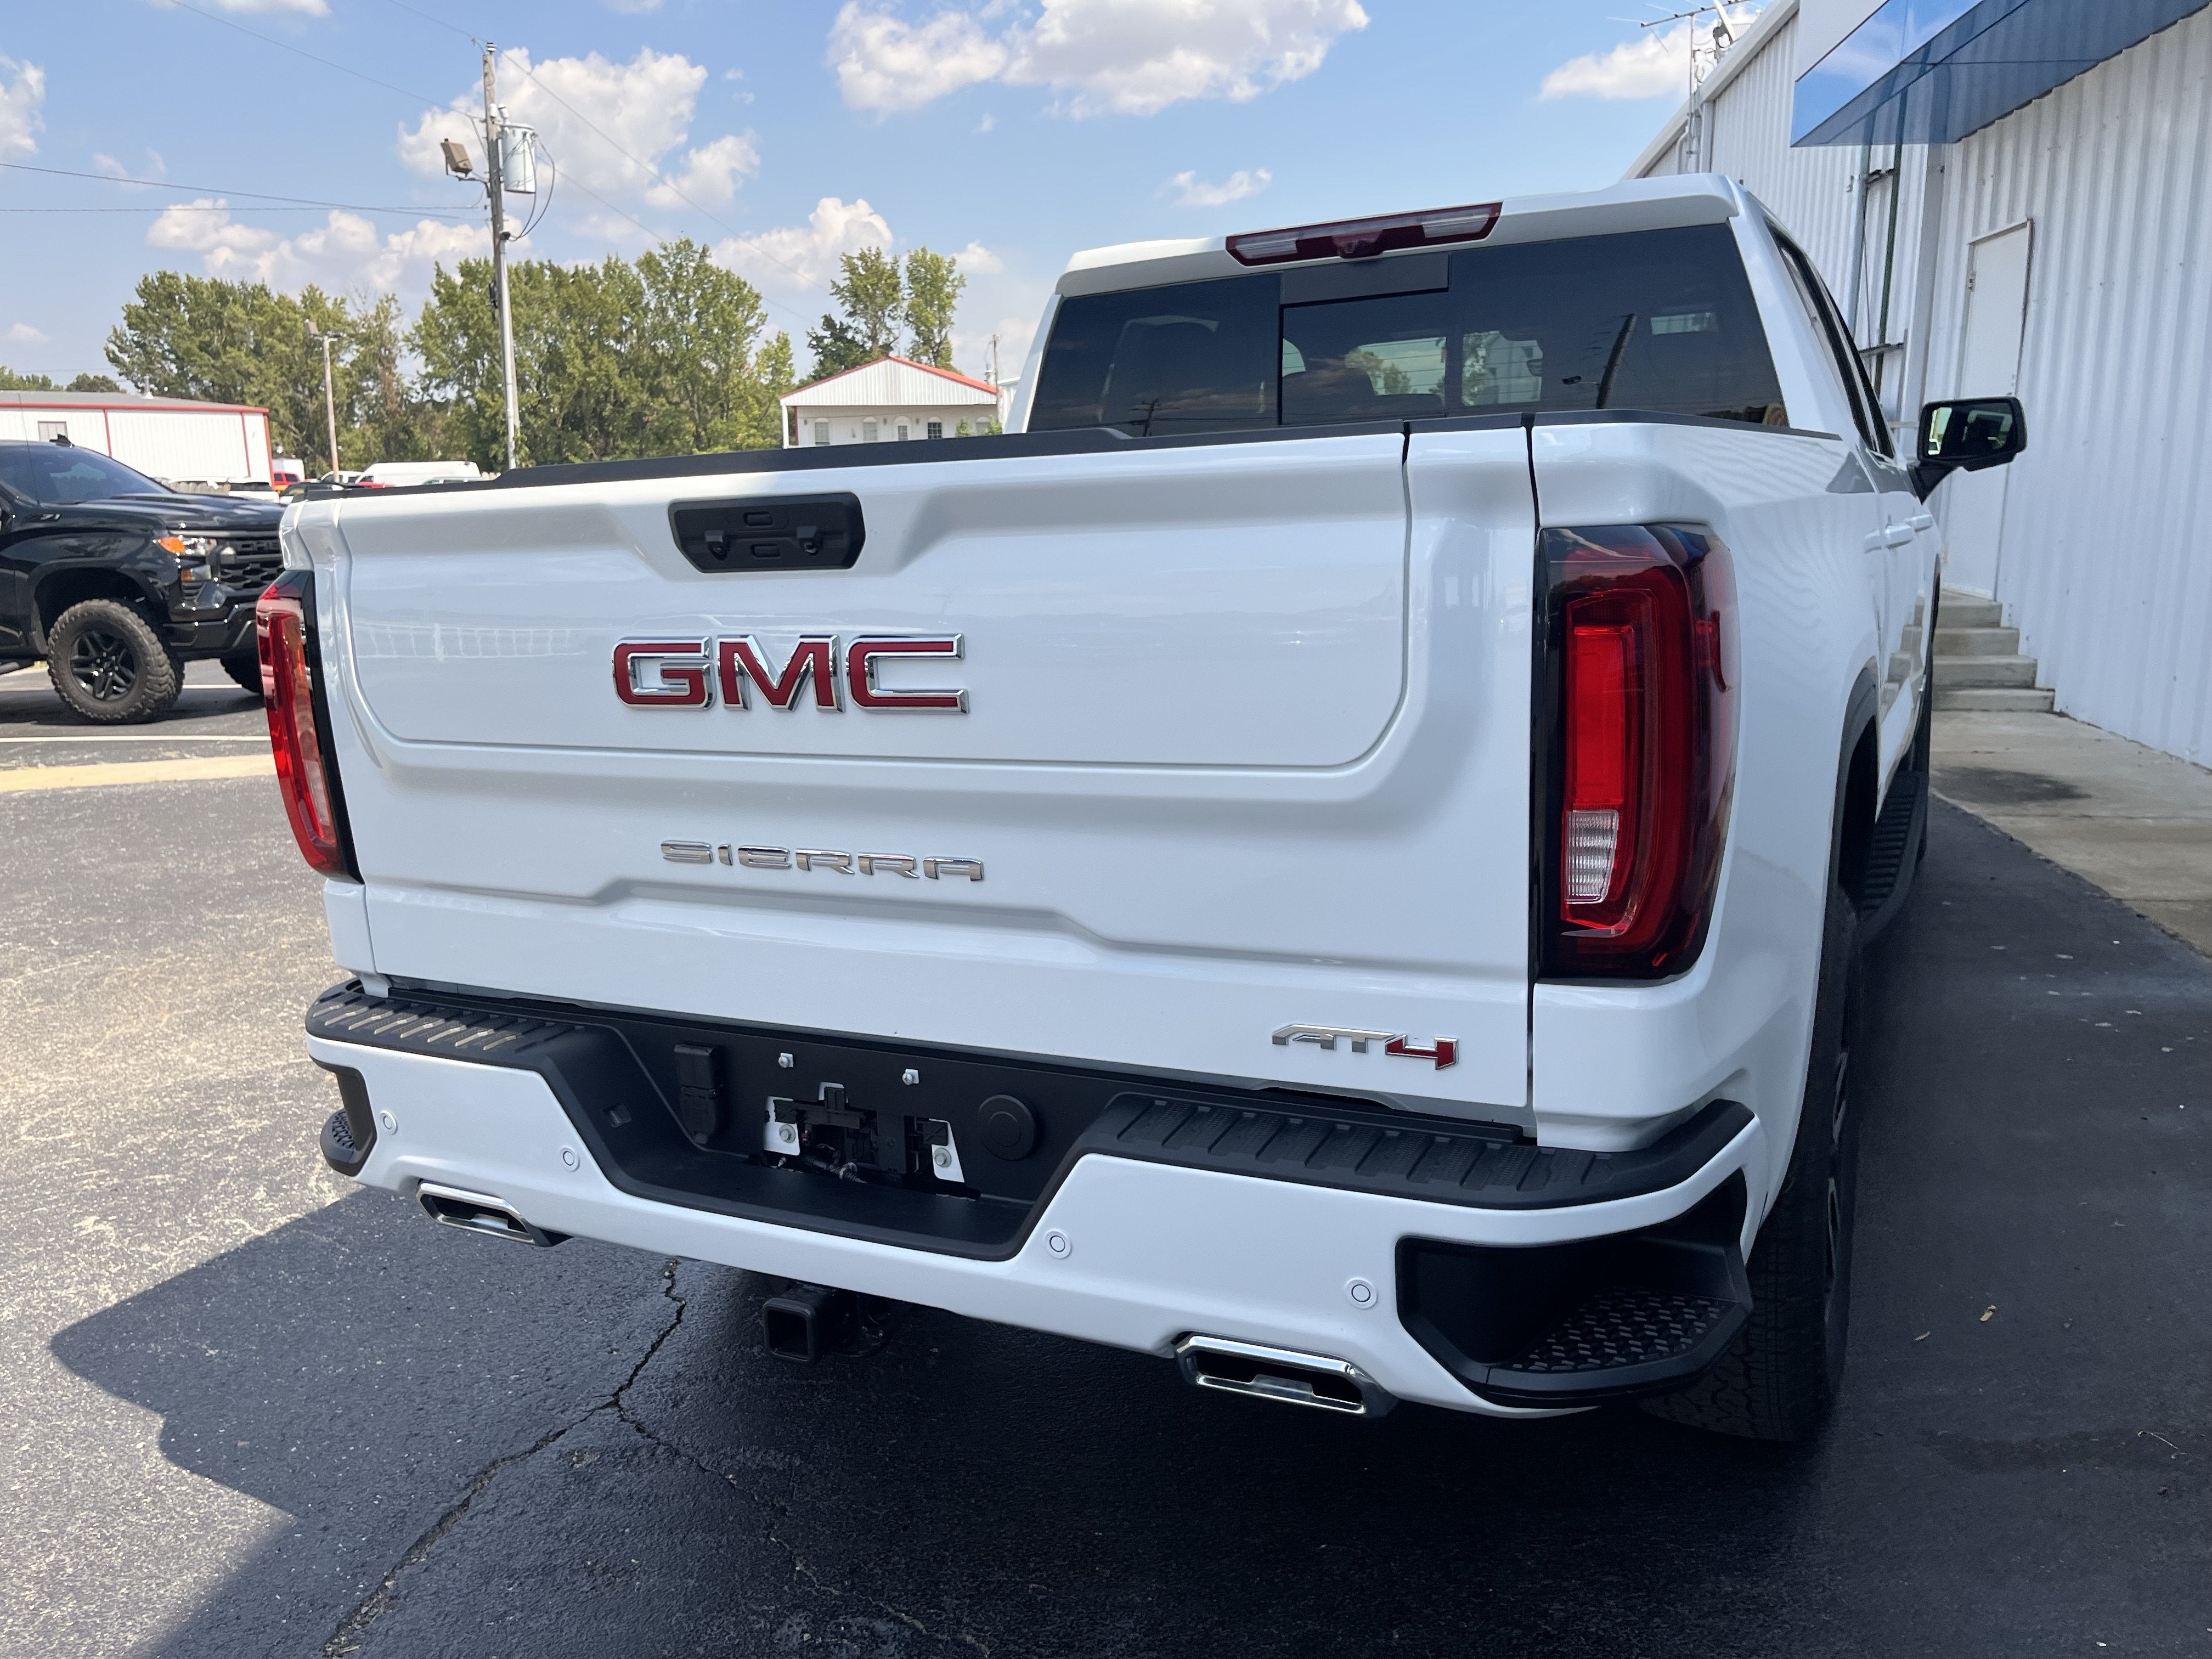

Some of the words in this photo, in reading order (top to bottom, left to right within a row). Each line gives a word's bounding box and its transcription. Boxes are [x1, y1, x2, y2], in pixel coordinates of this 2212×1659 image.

[612, 634, 969, 713] GMC
[661, 840, 985, 882] SIERRA
[1272, 1023, 1459, 1070] AT4
